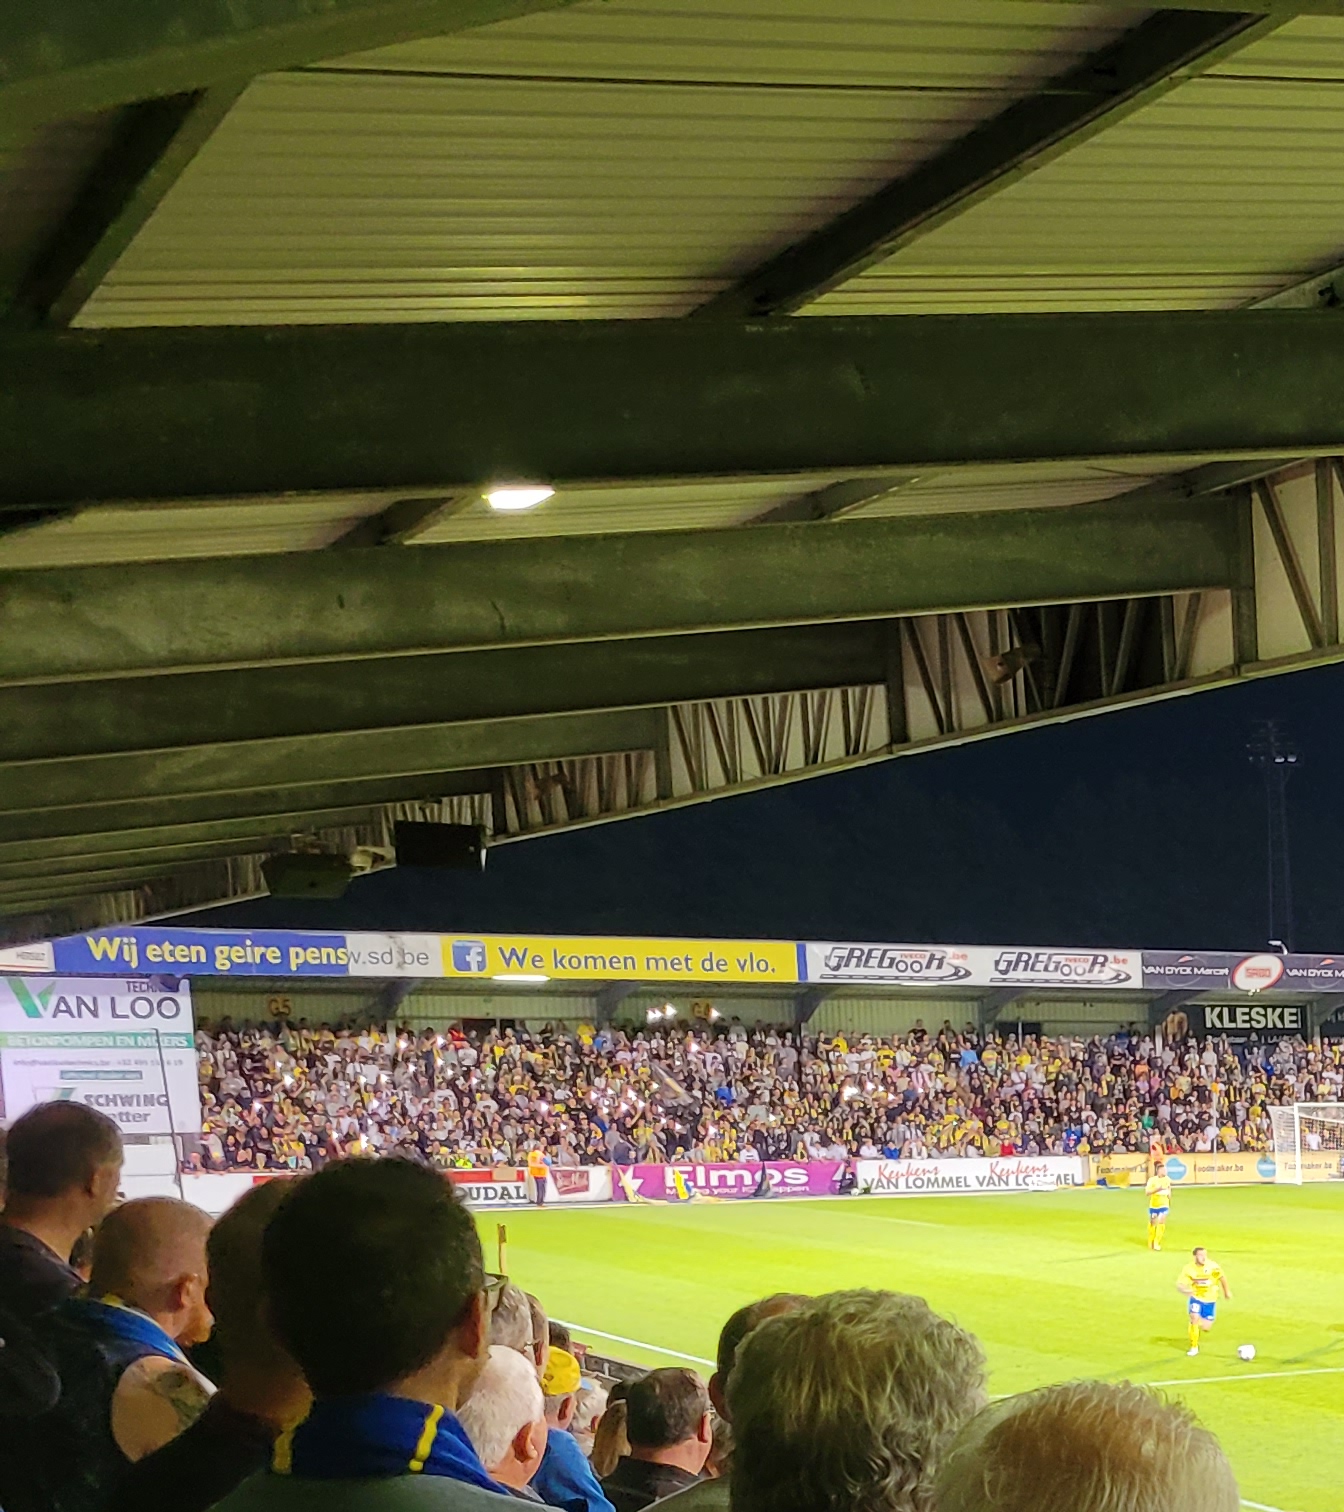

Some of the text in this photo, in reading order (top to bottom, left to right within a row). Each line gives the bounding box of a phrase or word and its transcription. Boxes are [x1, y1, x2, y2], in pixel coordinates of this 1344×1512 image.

[86, 936, 348, 971] Wij eten geire pens
[498, 947, 776, 974] We komen met de vlo.
[110, 996, 181, 1019] LOO
[1205, 1006, 1298, 1029] KLESKE
[84, 1093, 169, 1107] SCHWING
[864, 1175, 971, 1190] VAN LOMMEL
[975, 1175, 1009, 1188] VAN
[453, 1186, 528, 1201] OUDAL
